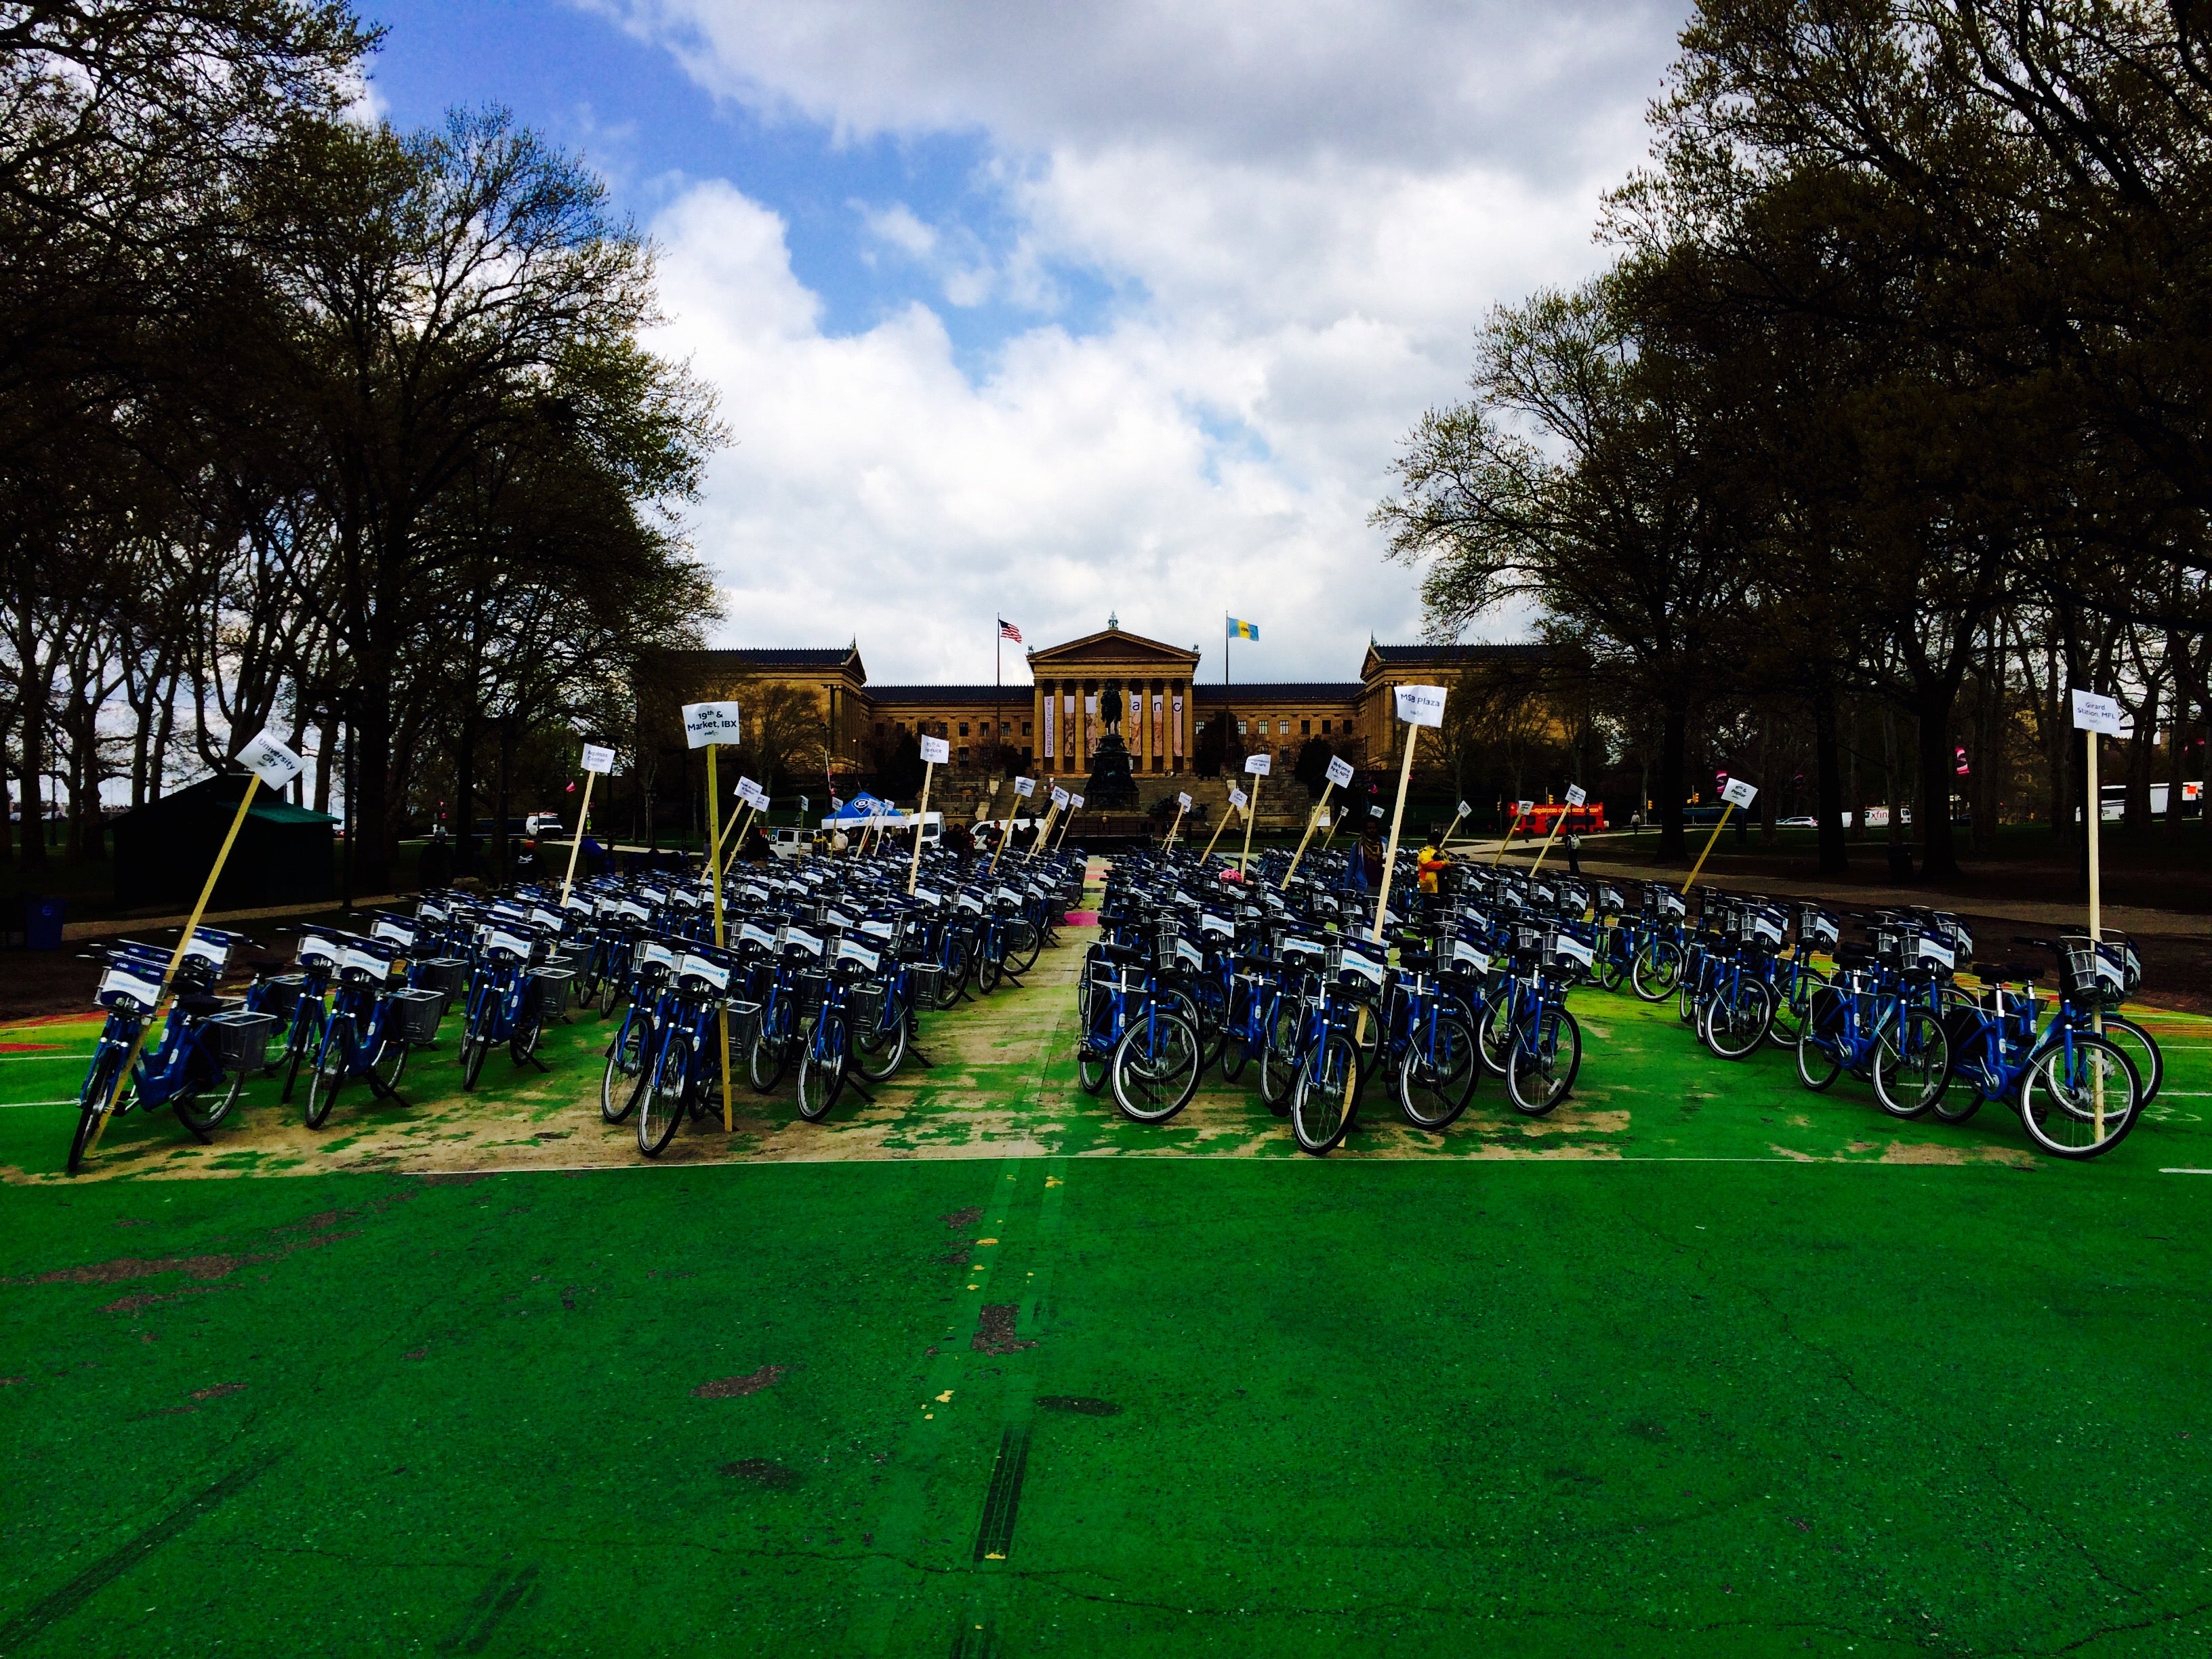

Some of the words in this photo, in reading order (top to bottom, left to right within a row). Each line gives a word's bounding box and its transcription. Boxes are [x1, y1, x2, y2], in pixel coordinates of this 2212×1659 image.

[1401, 693, 1416, 703] MSB
[1417, 697, 1440, 707] Plaza
[2085, 702, 2106, 710] Girard
[698, 710, 714, 720] 19th
[2077, 708, 2100, 718] Station,
[687, 720, 720, 731] Market,
[721, 720, 737, 728] IBX
[258, 738, 295, 771] University
[262, 754, 278, 767] City
[691, 946, 729, 960] ridego.com
[1344, 958, 1375, 972] Independence
